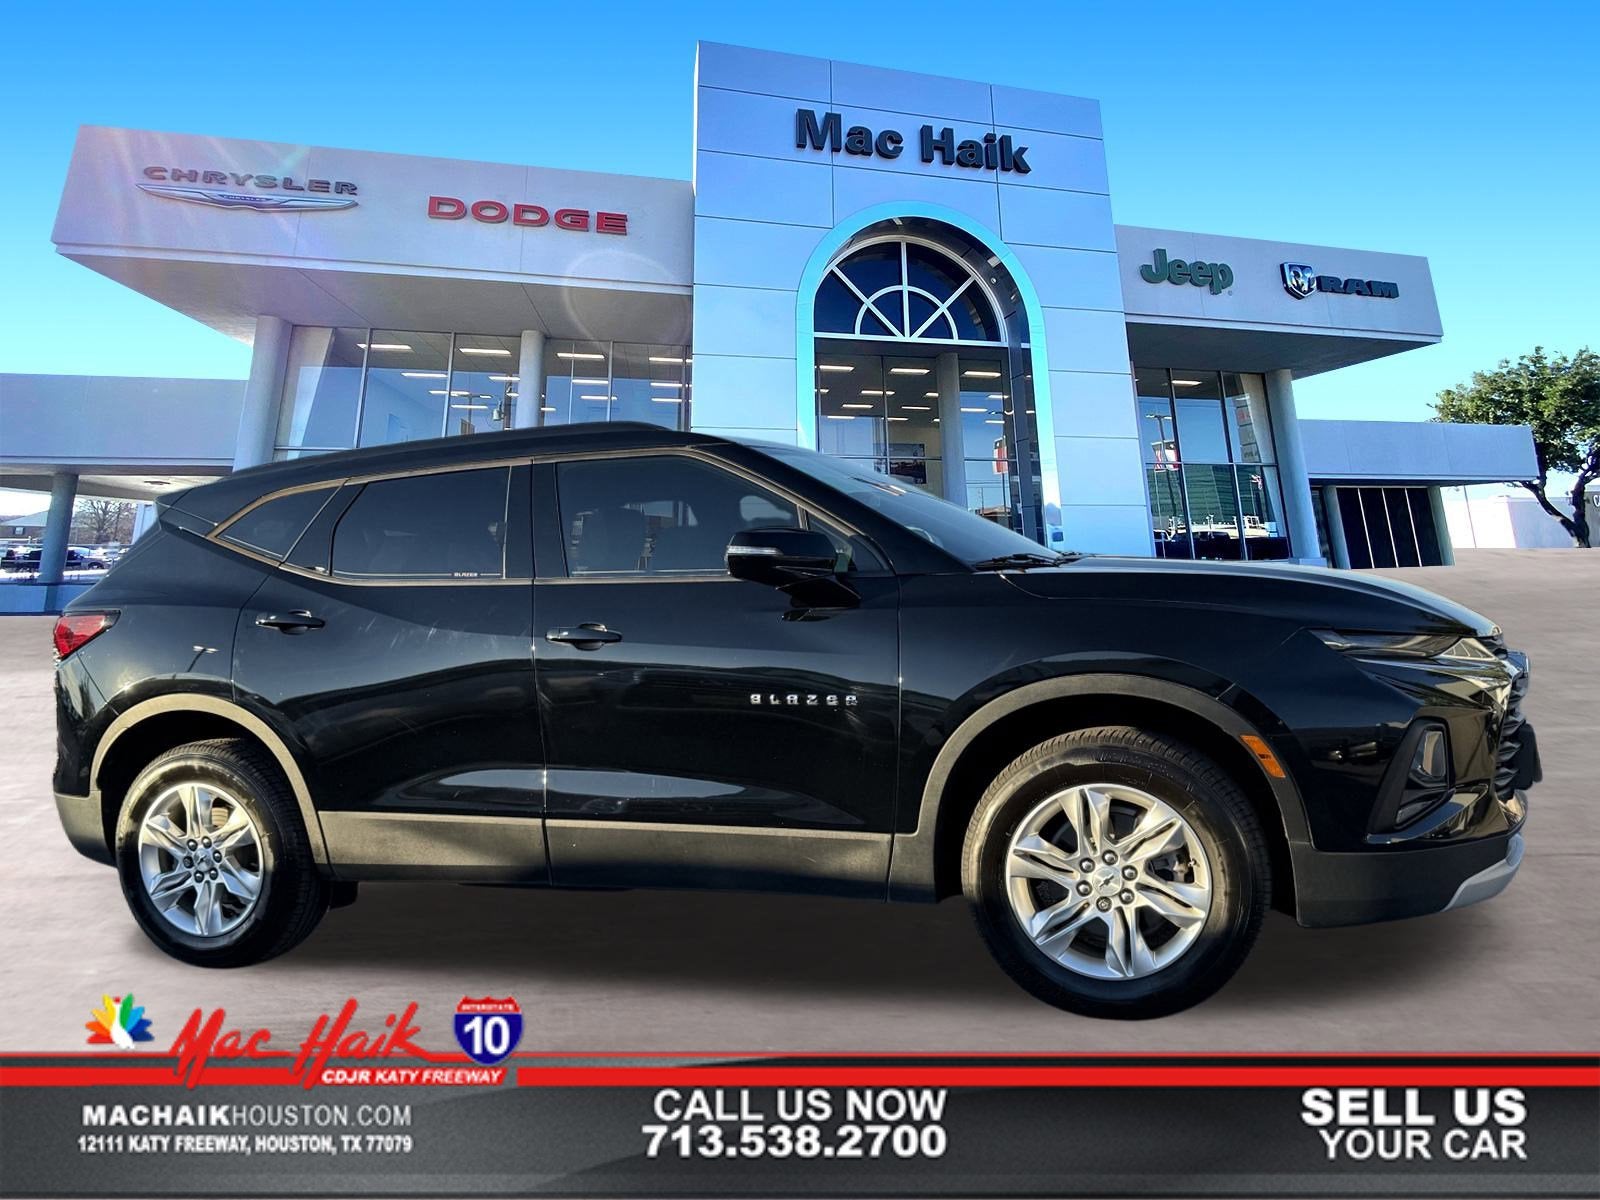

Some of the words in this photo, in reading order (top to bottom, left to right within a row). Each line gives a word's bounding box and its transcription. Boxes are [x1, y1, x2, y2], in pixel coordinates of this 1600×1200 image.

[796, 108, 904, 159] Mac
[920, 124, 1031, 174] Haik
[143, 165, 358, 196] CHRYSLER
[428, 196, 628, 235] DODGE
[1139, 248, 1234, 295] Jeep
[1316, 275, 1399, 299] RAM
[750, 693, 858, 706] BLAZER
